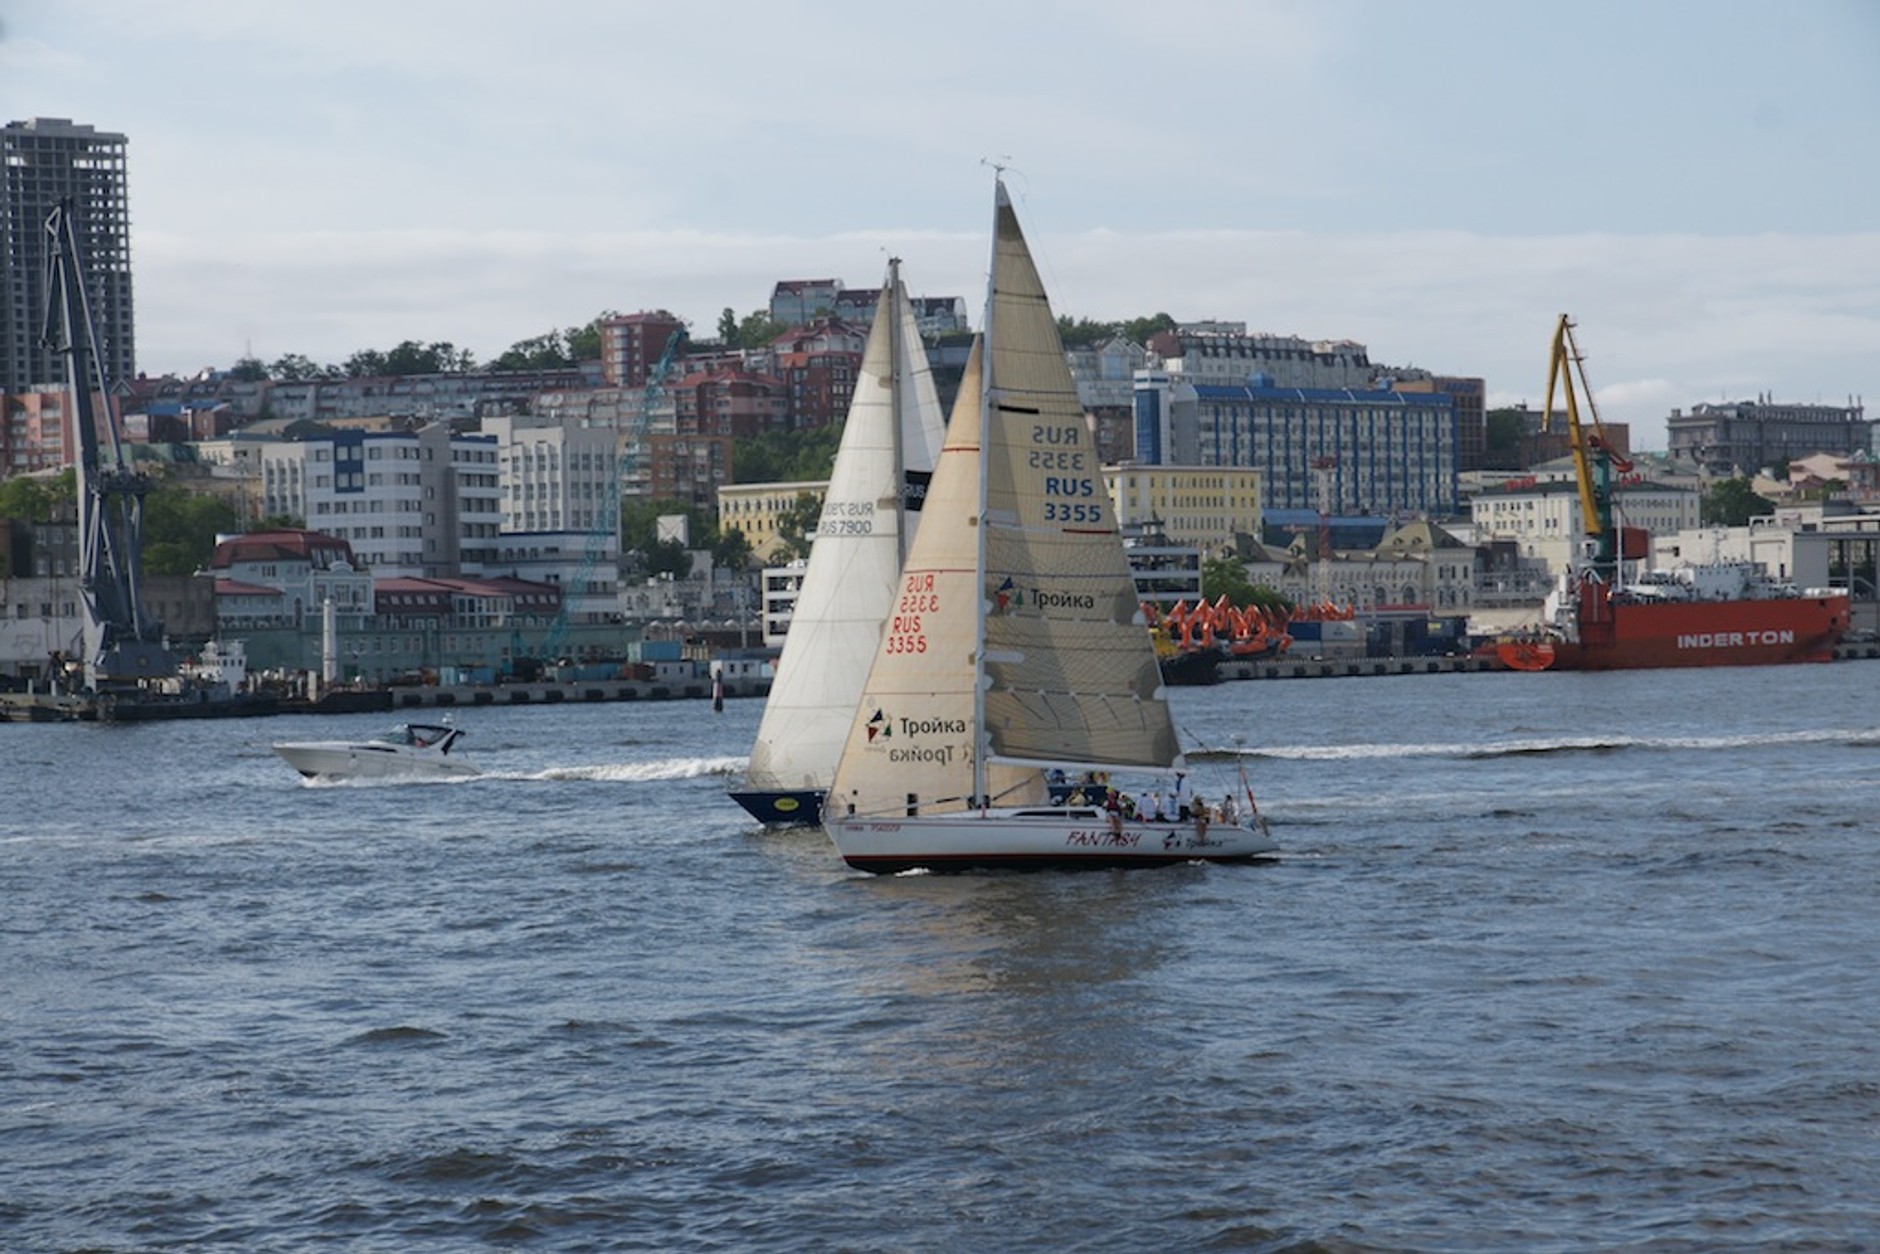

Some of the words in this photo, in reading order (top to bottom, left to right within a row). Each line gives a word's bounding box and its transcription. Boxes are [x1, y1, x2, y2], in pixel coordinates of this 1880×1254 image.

[1046, 477, 1093, 496] RUS
[1044, 503, 1101, 522] 3355
[1030, 589, 1094, 609] Тройка
[892, 616, 921, 633] RUS
[886, 635, 926, 654] 3355
[900, 717, 965, 738] Тройка
[1066, 832, 1142, 848] FANTASY
